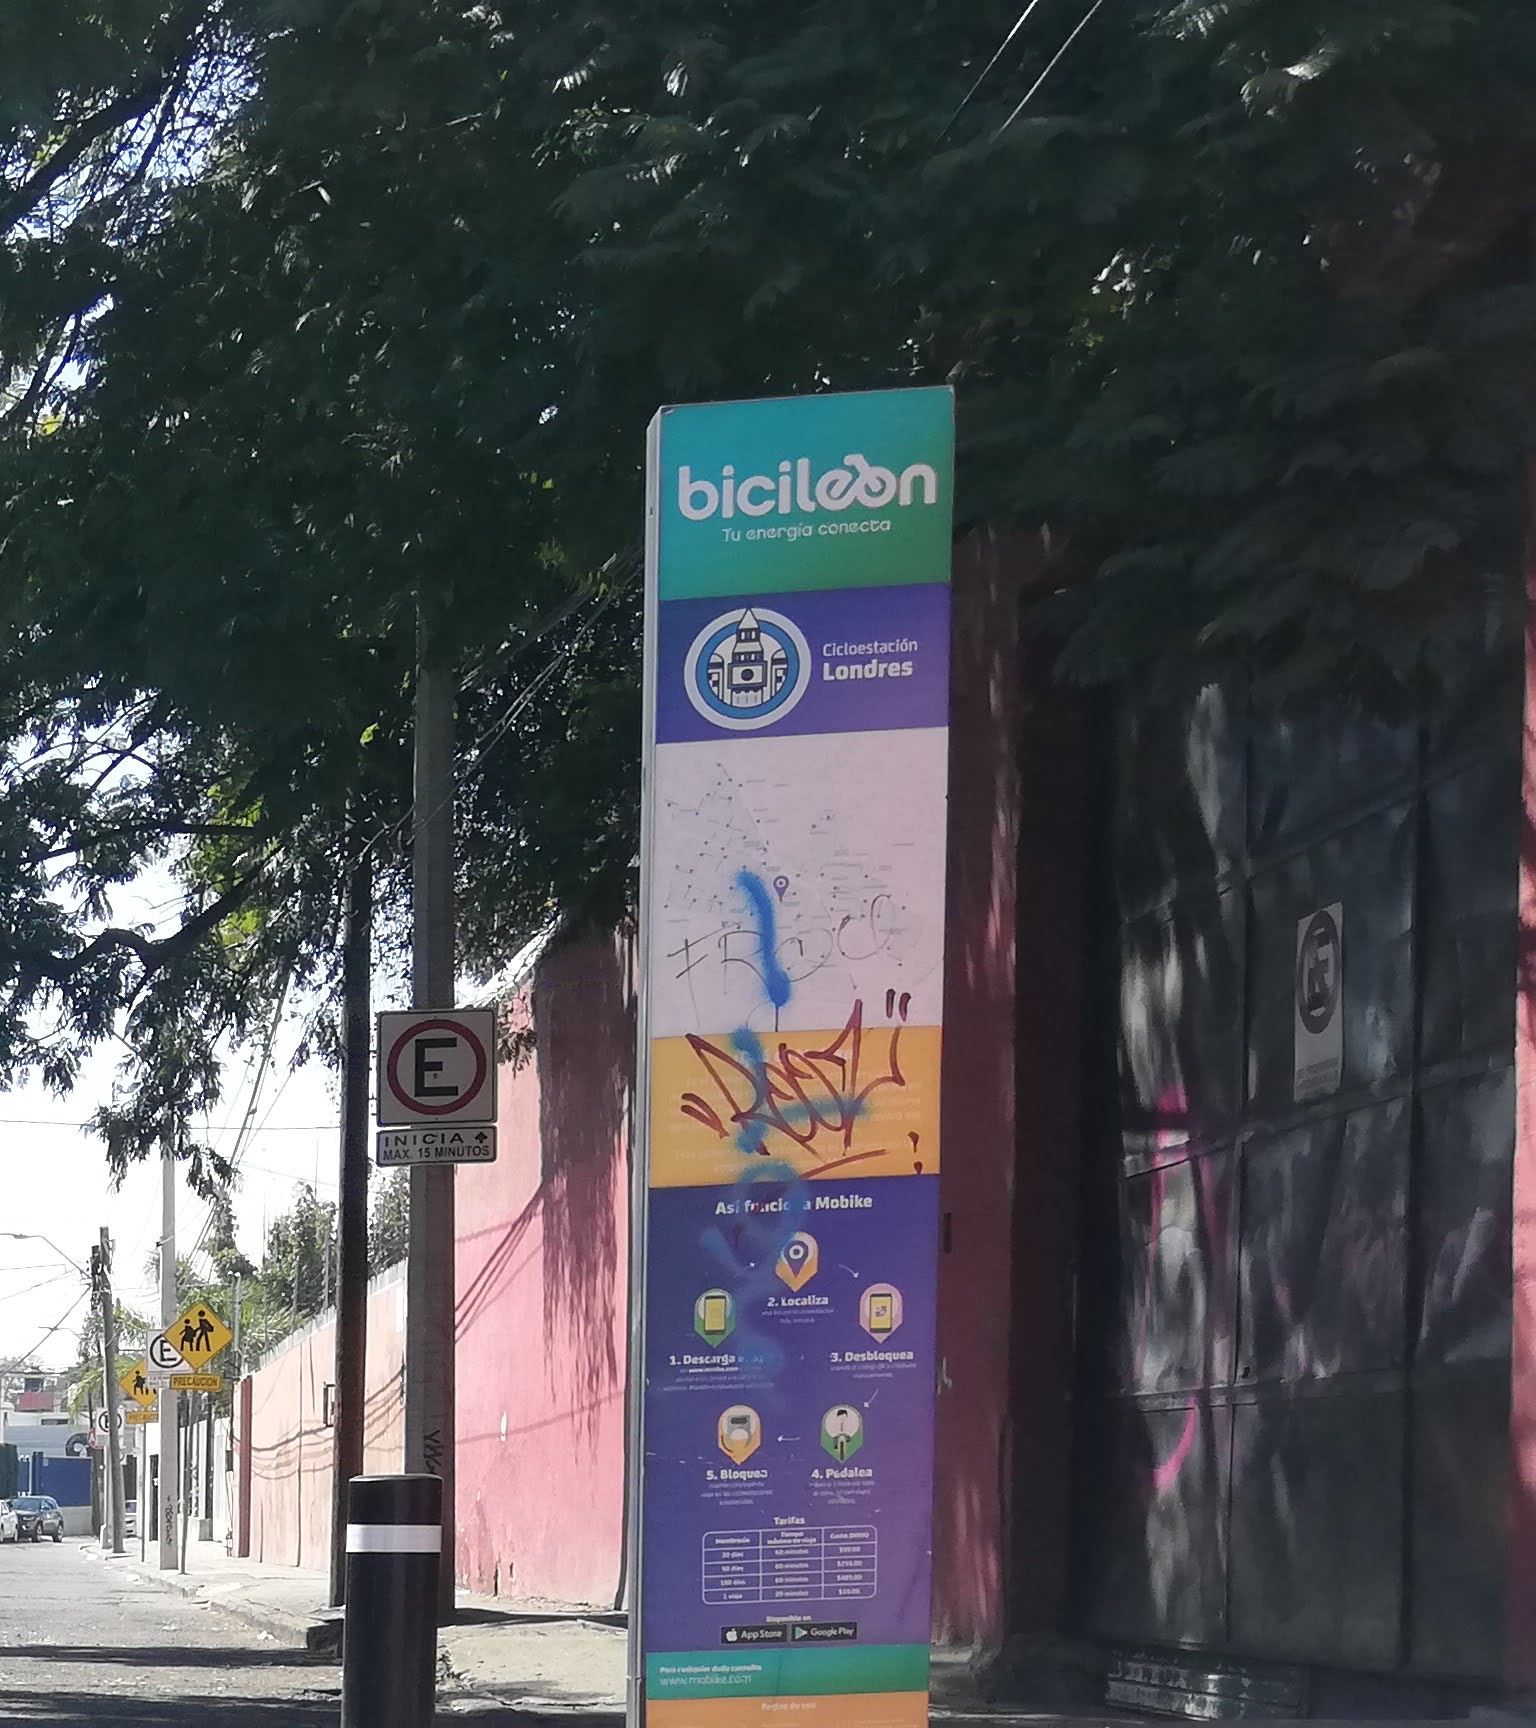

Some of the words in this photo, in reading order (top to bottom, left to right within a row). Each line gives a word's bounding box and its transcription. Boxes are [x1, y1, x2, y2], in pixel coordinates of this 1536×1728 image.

[722, 527, 741, 543] Tu
[817, 519, 891, 536] conecta
[823, 638, 918, 658] Cicloestación
[823, 659, 913, 682] Londres
[414, 1037, 459, 1098] E
[385, 1132, 465, 1148] INICIA
[383, 1148, 413, 1161] MAX.
[418, 1147, 431, 1159] 15
[434, 1144, 490, 1159] MINUTOS
[815, 1194, 873, 1211] Mobike
[767, 1296, 779, 1307] 2.
[781, 1295, 829, 1307] Localiza
[669, 1355, 681, 1366] 1.
[683, 1353, 736, 1366] Descarga
[830, 1352, 842, 1363] 3.
[844, 1350, 914, 1363] Desbloquea
[706, 1469, 718, 1481] 5.
[720, 1469, 768, 1481] Bloquea
[811, 1469, 823, 1480] 4.
[825, 1467, 873, 1479] Pedalea
[773, 1516, 806, 1526] Tarifas
[740, 1629, 759, 1640] App
[760, 1629, 783, 1638] Store
[810, 1626, 838, 1637] Google
[838, 1626, 855, 1636] Play
